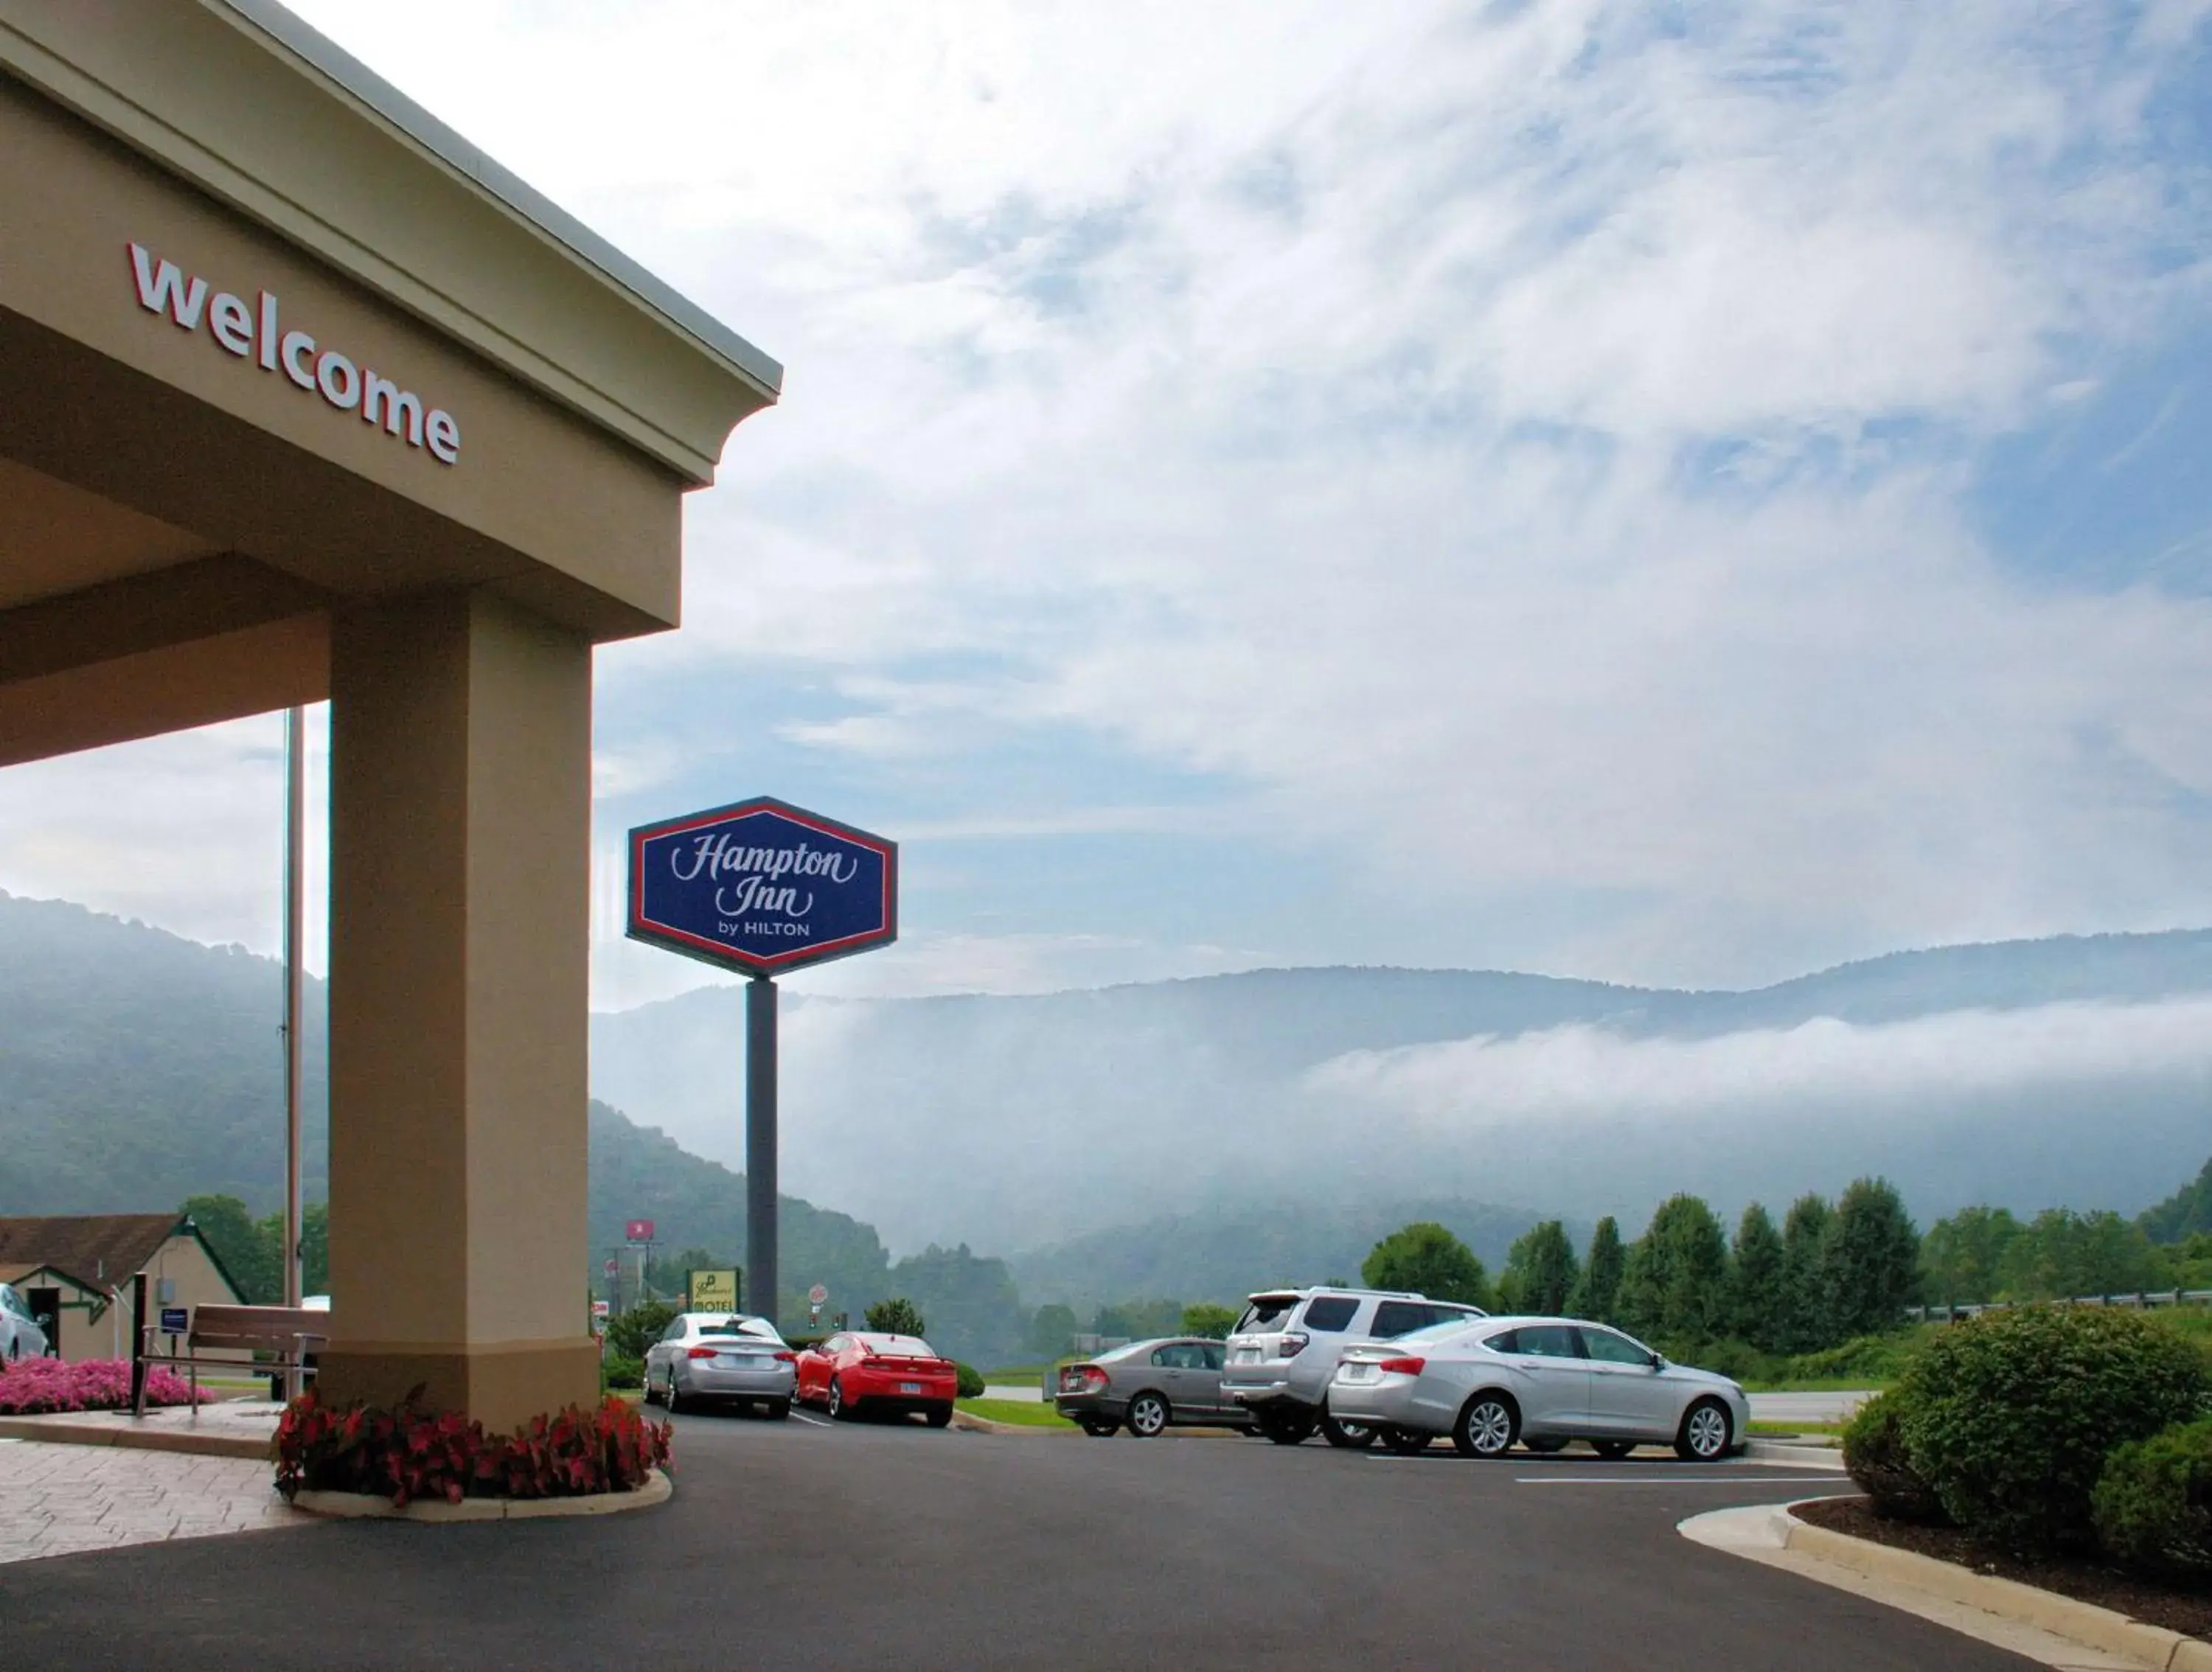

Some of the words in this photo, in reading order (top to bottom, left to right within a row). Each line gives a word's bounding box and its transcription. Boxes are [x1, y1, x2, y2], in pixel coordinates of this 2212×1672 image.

[127, 241, 460, 465] welcome
[671, 833, 858, 883] Hampton
[715, 876, 813, 916] Inn
[718, 922, 738, 936] by
[744, 922, 810, 936] HILTON
[694, 1301, 733, 1312] MOTEL
